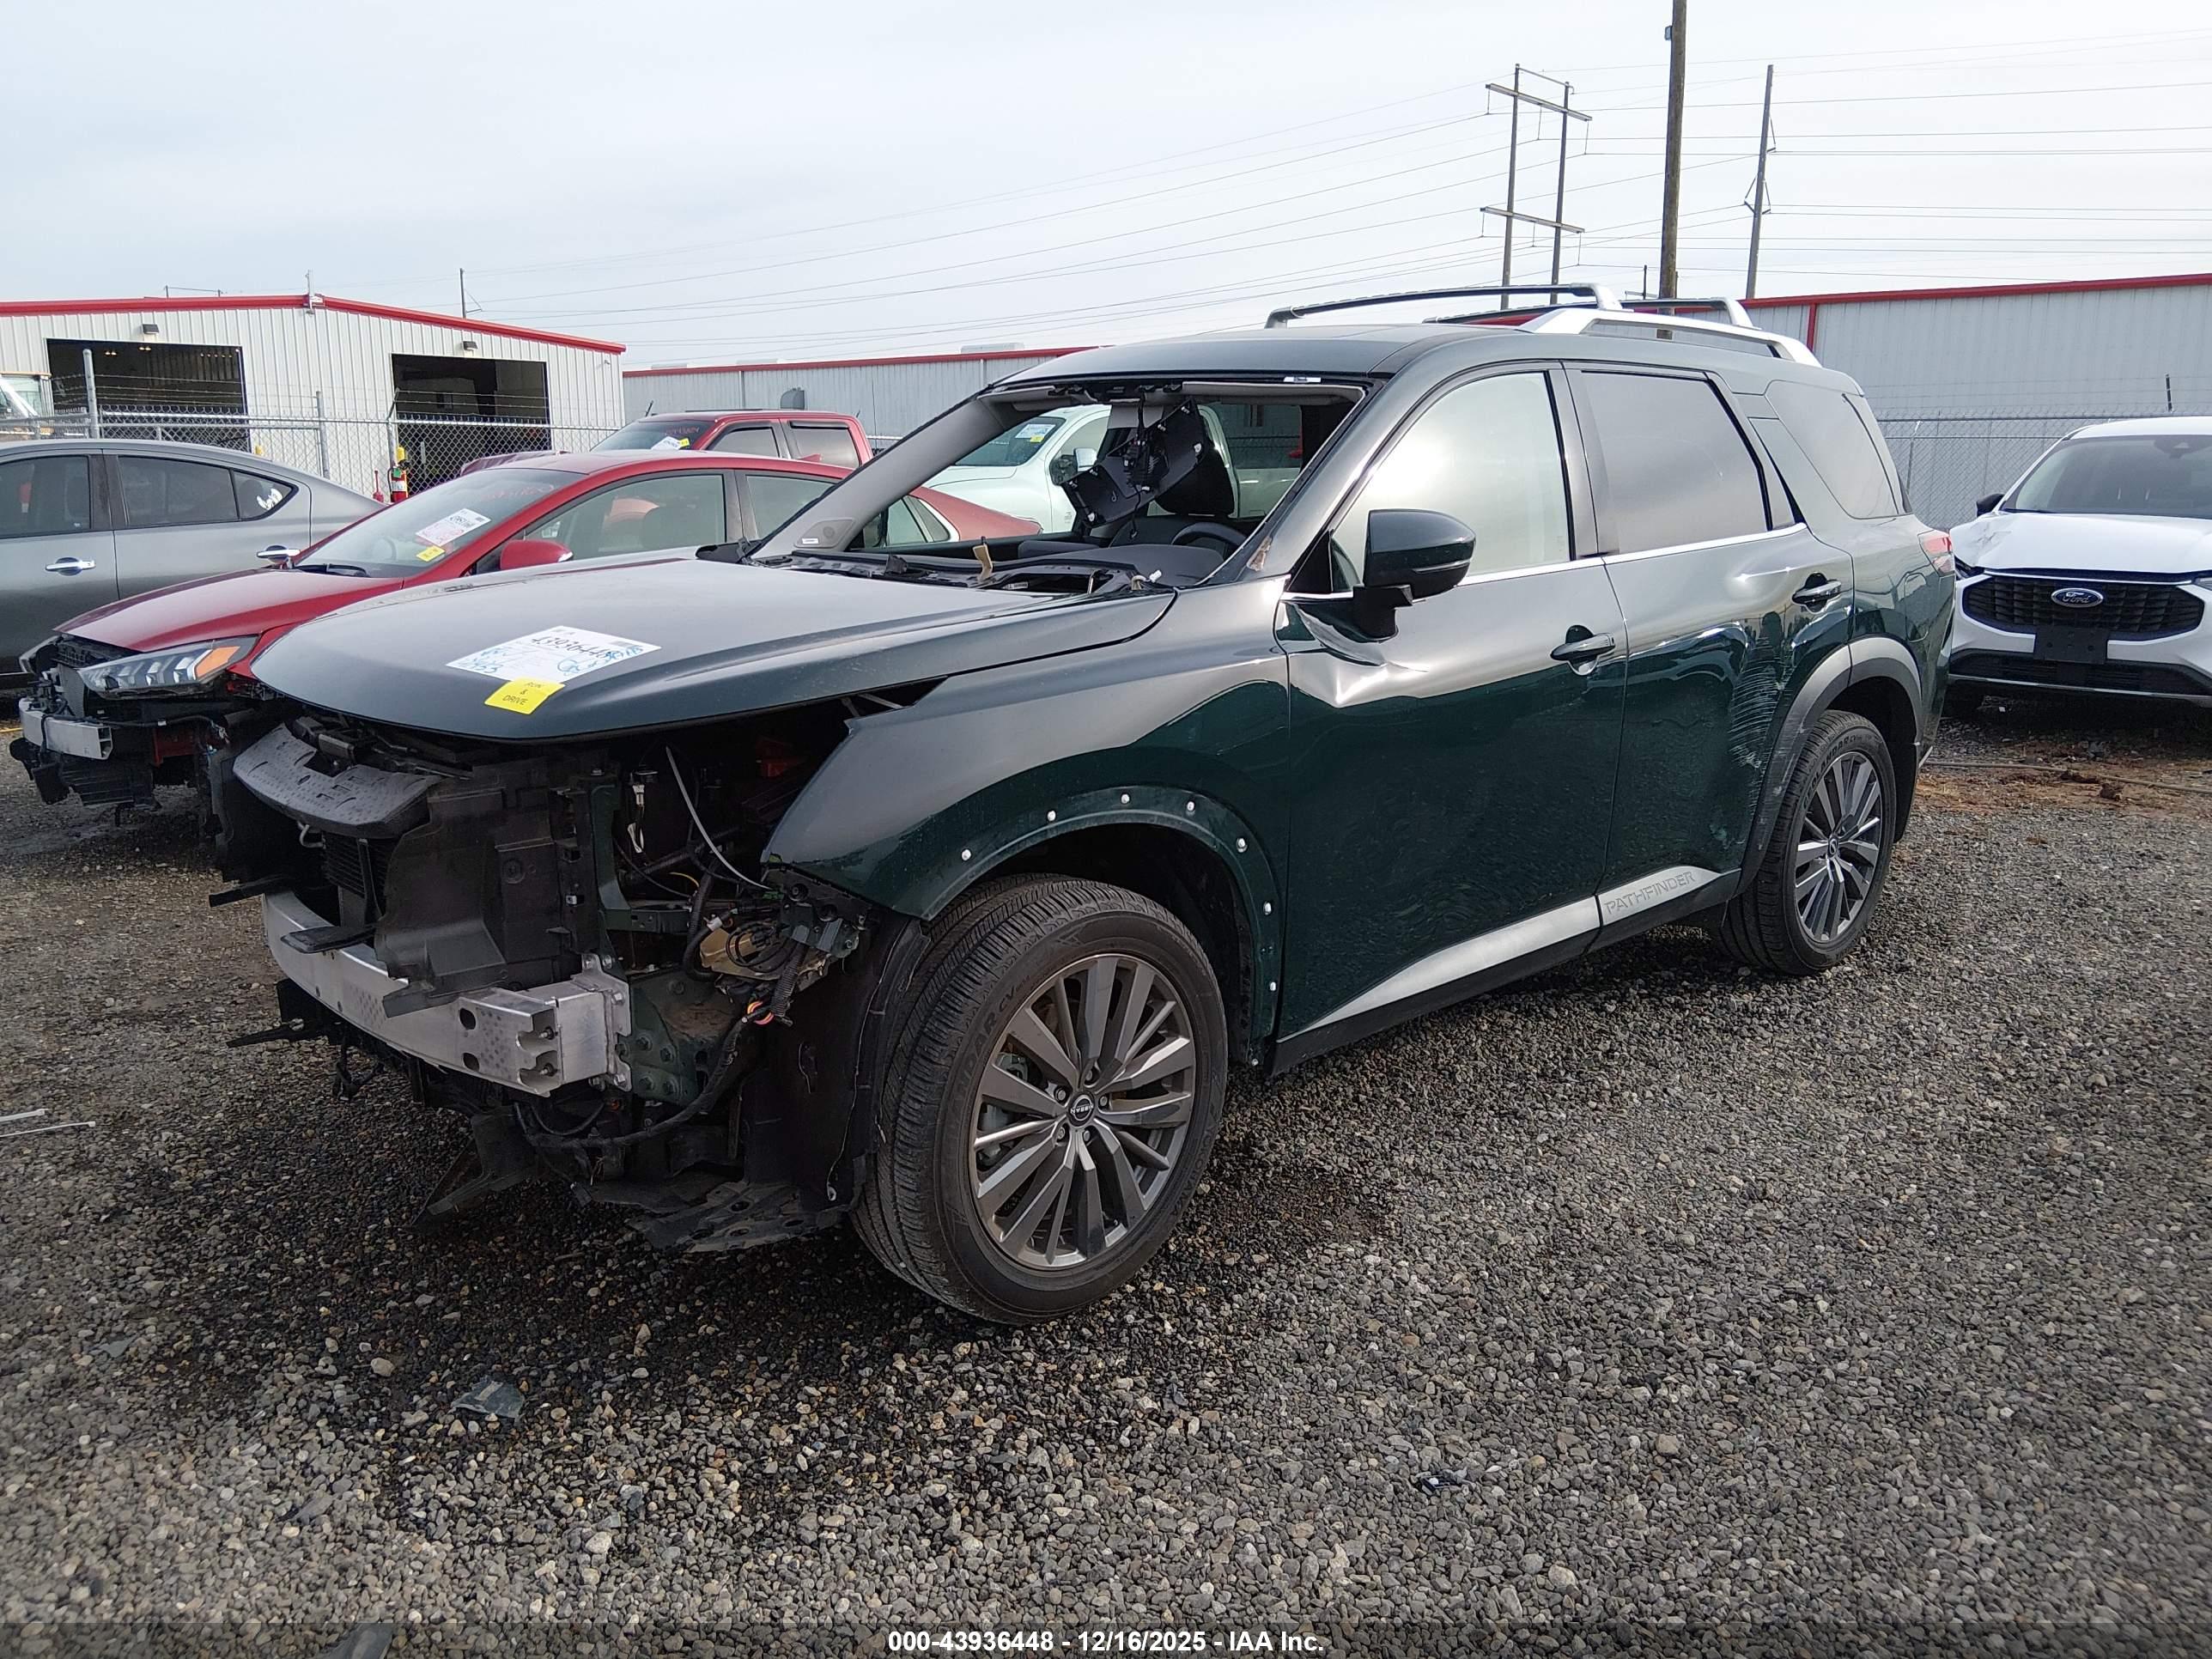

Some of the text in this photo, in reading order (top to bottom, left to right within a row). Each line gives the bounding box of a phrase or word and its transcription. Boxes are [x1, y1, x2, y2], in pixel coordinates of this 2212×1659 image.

[2062, 591, 2091, 604] Ford
[502, 695, 528, 706] DRIVE
[1604, 871, 1696, 915] PATHFINDER
[1070, 1103, 1094, 1115] NISSAN
